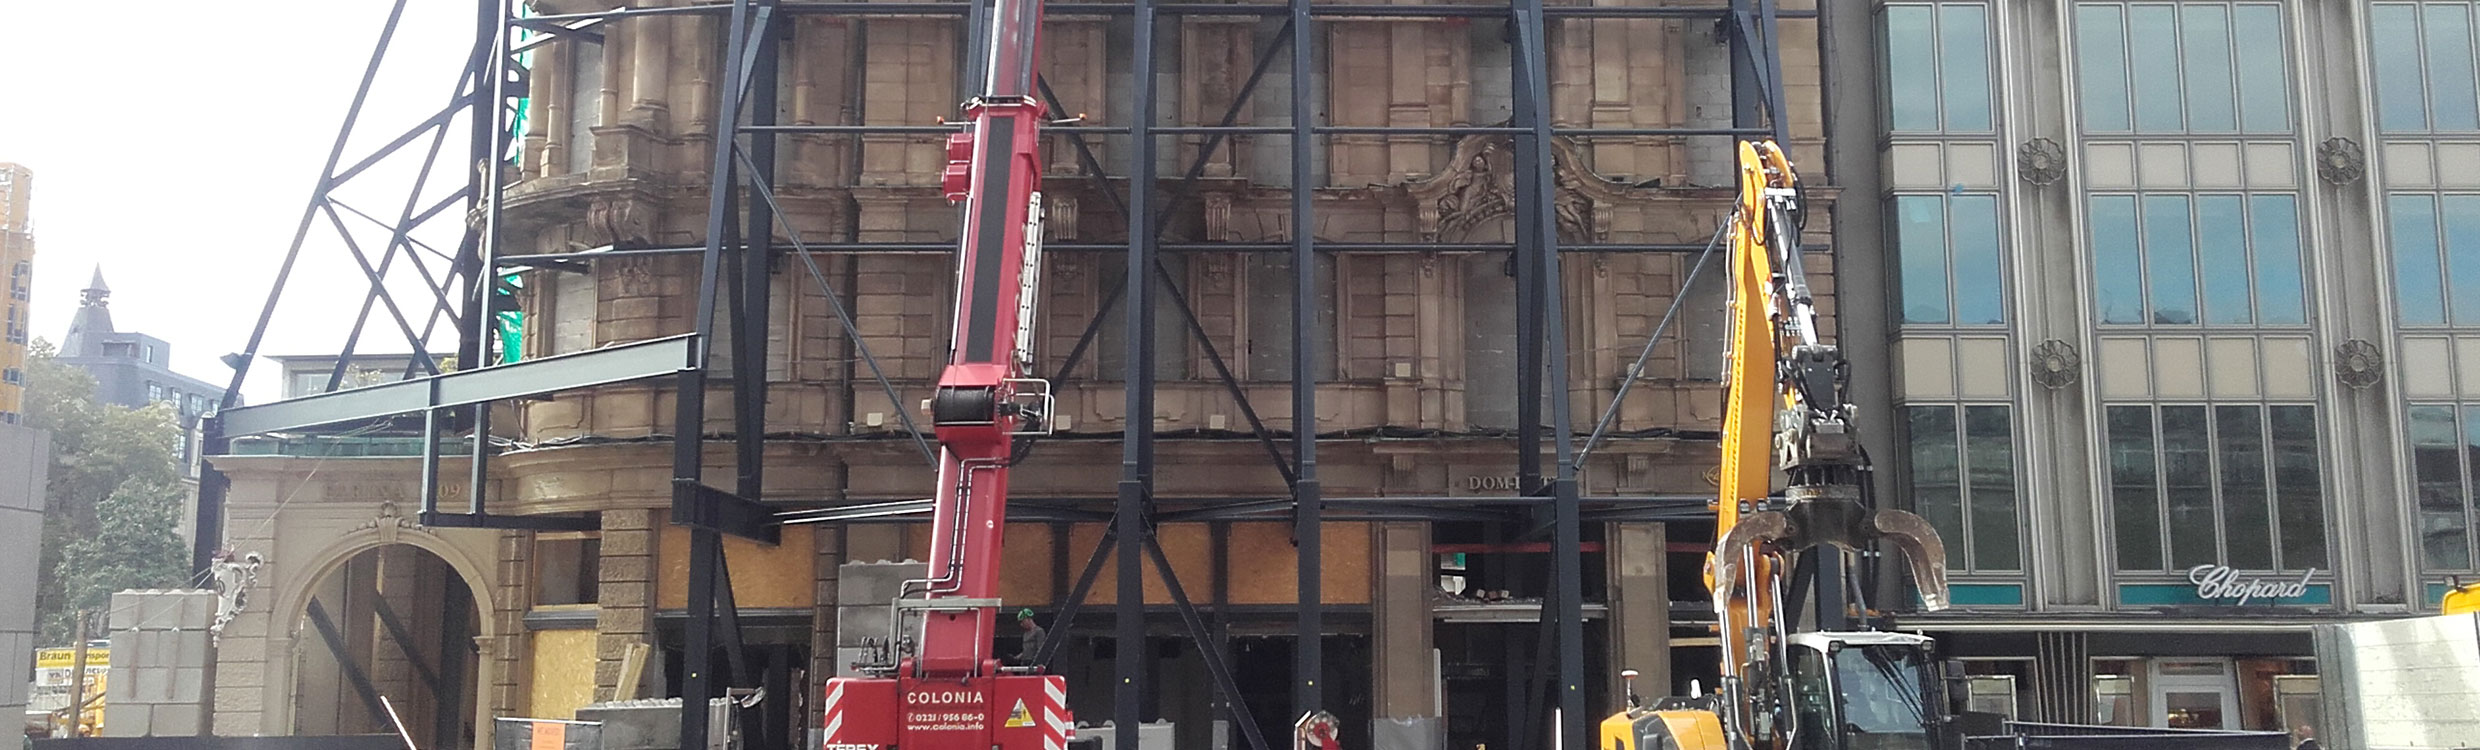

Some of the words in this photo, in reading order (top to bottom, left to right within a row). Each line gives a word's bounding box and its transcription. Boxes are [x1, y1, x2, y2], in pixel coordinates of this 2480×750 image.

[2189, 564, 2316, 606] Chopard
[40, 652, 71, 660] Braun
[907, 692, 984, 704] COLONIA
[915, 713, 937, 721] 0221
[907, 721, 985, 731] www.colonia.info
